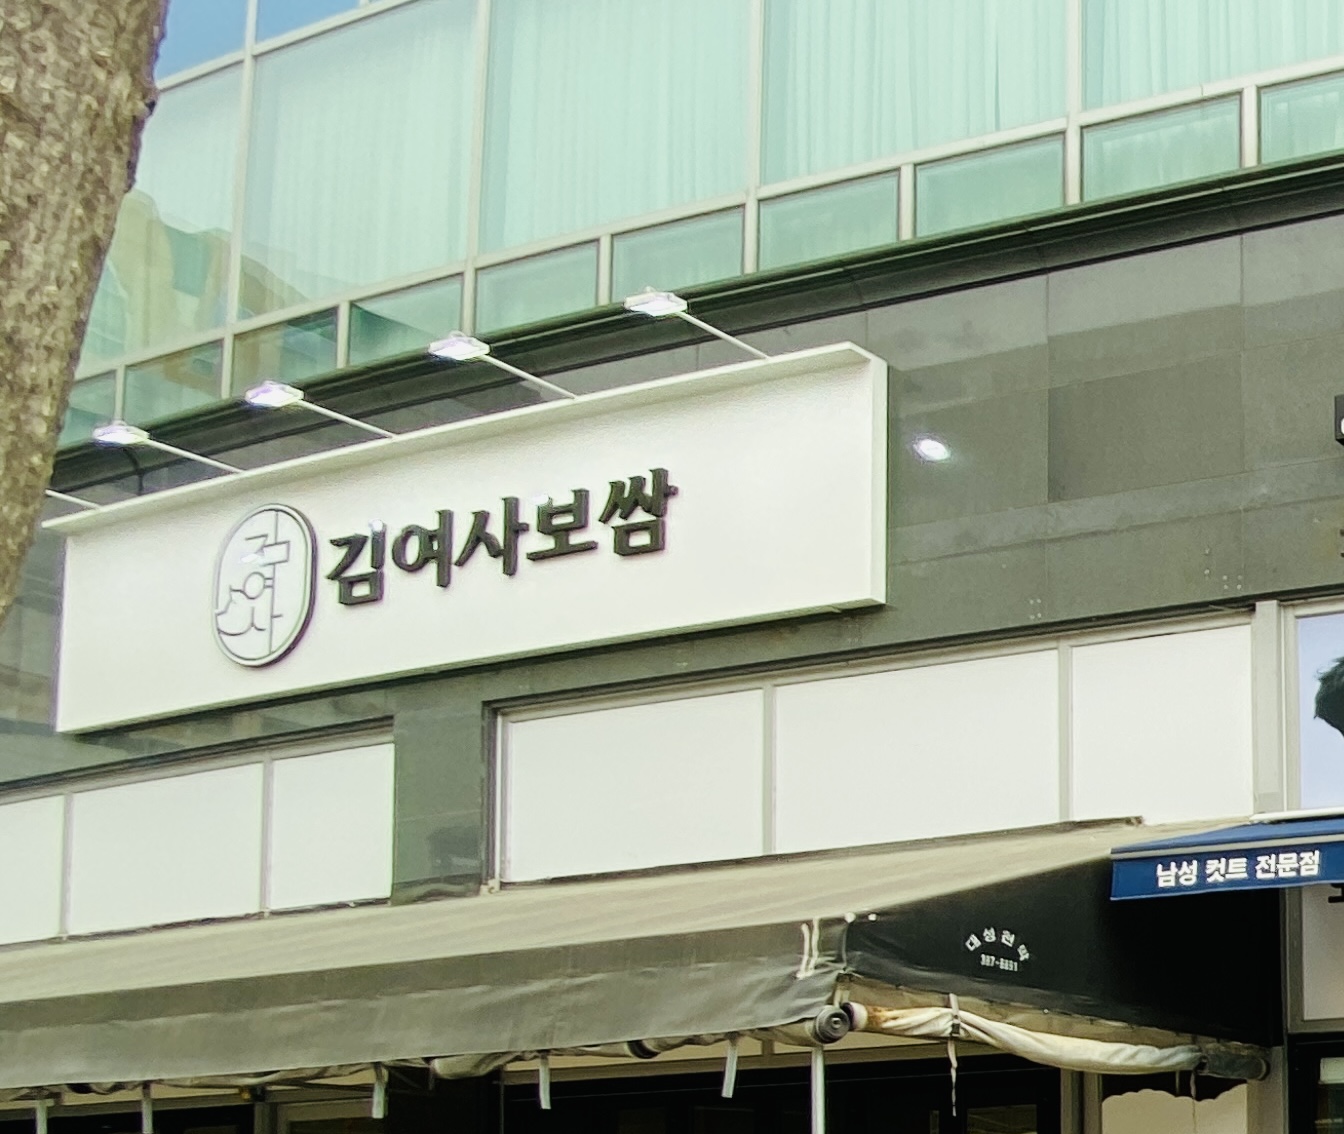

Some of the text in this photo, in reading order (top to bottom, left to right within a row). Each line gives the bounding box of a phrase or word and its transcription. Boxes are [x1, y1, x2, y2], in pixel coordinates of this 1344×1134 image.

[326, 467, 679, 606] 김여사보쌈
[1157, 861, 1198, 888] 남성
[1255, 850, 1320, 880] 전문점
